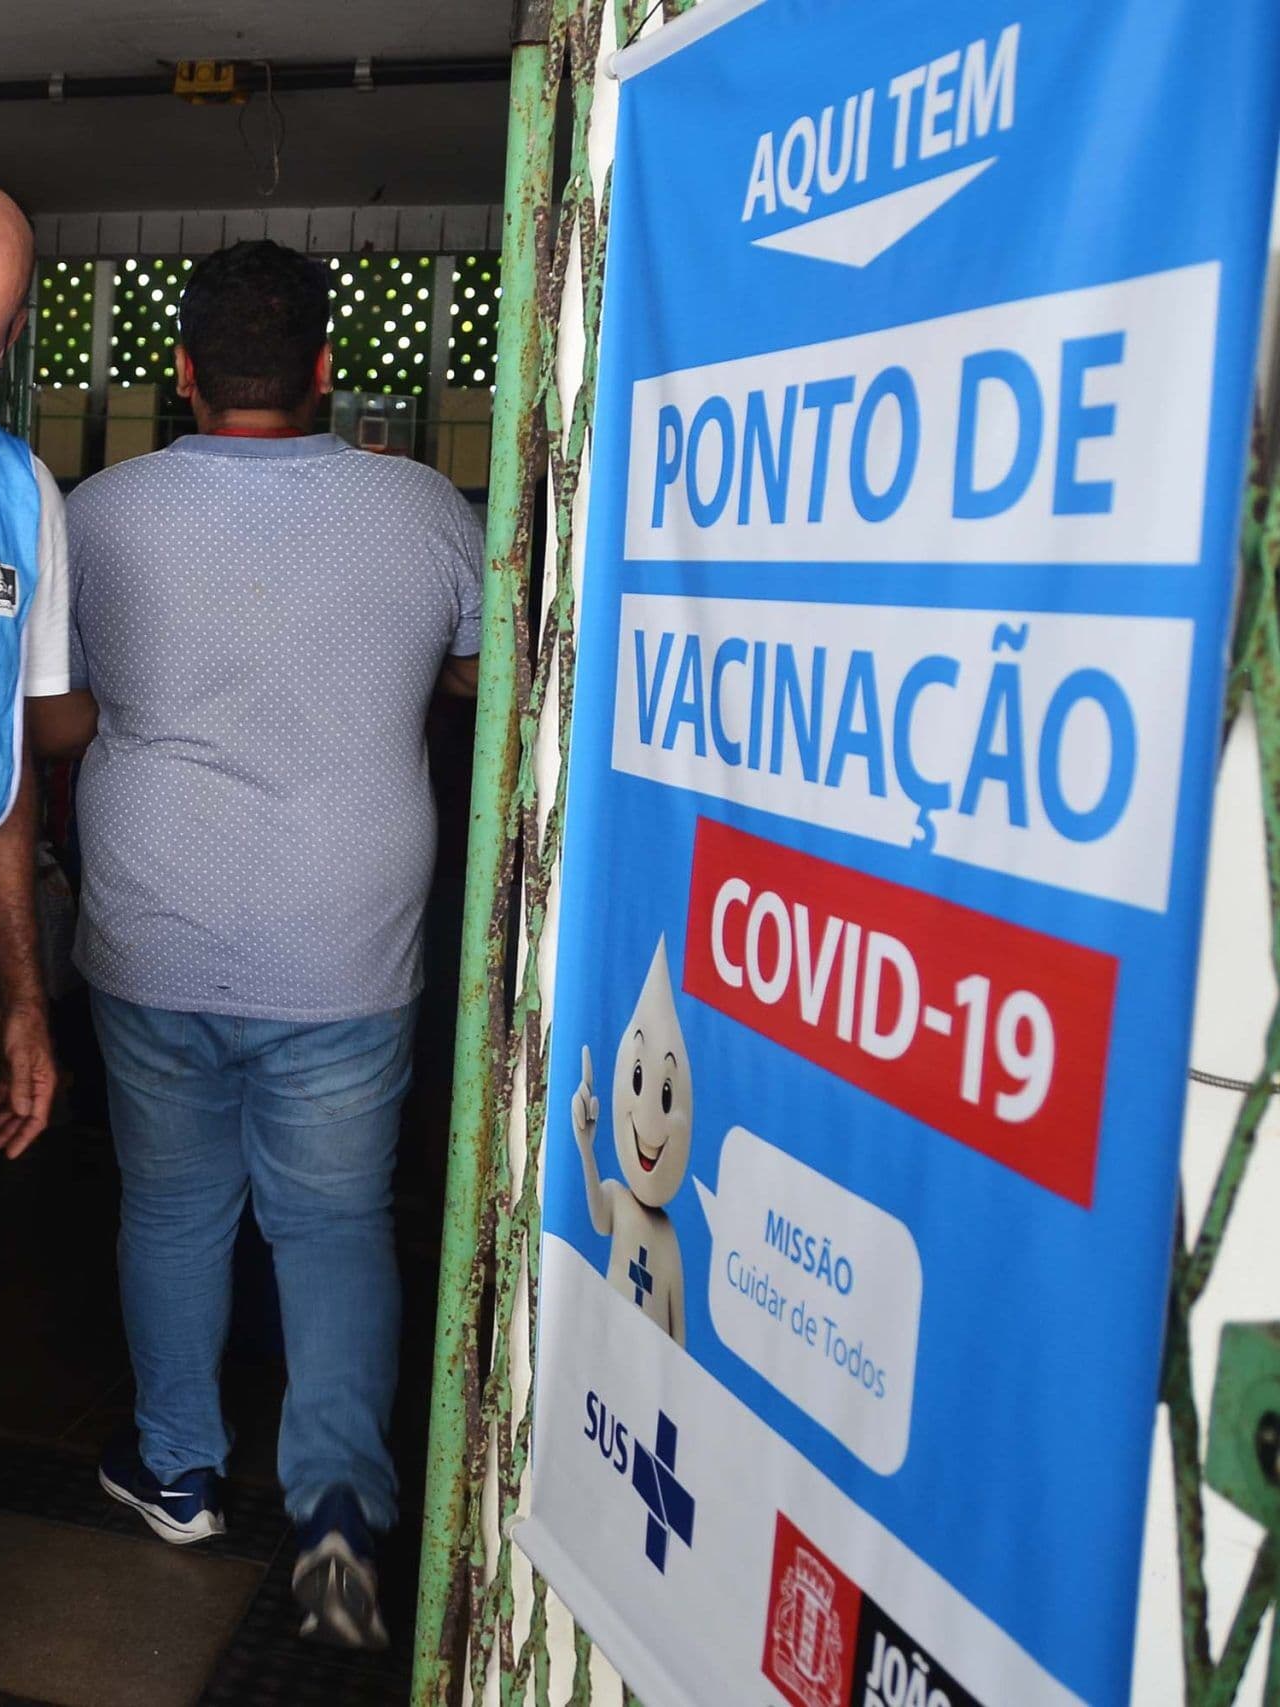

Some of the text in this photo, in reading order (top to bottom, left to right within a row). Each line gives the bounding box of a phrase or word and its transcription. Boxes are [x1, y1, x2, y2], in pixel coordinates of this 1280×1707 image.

[741, 22, 1020, 222] AQUI TEM
[651, 330, 1126, 529] PONTO DE
[634, 622, 1138, 855] VACINAÇÃO
[711, 877, 1055, 1124] COVID-19
[727, 1250, 887, 1399] Cuidar de Todos
[764, 1208, 853, 1296] MISSÃO
[584, 1390, 628, 1475] SUS
